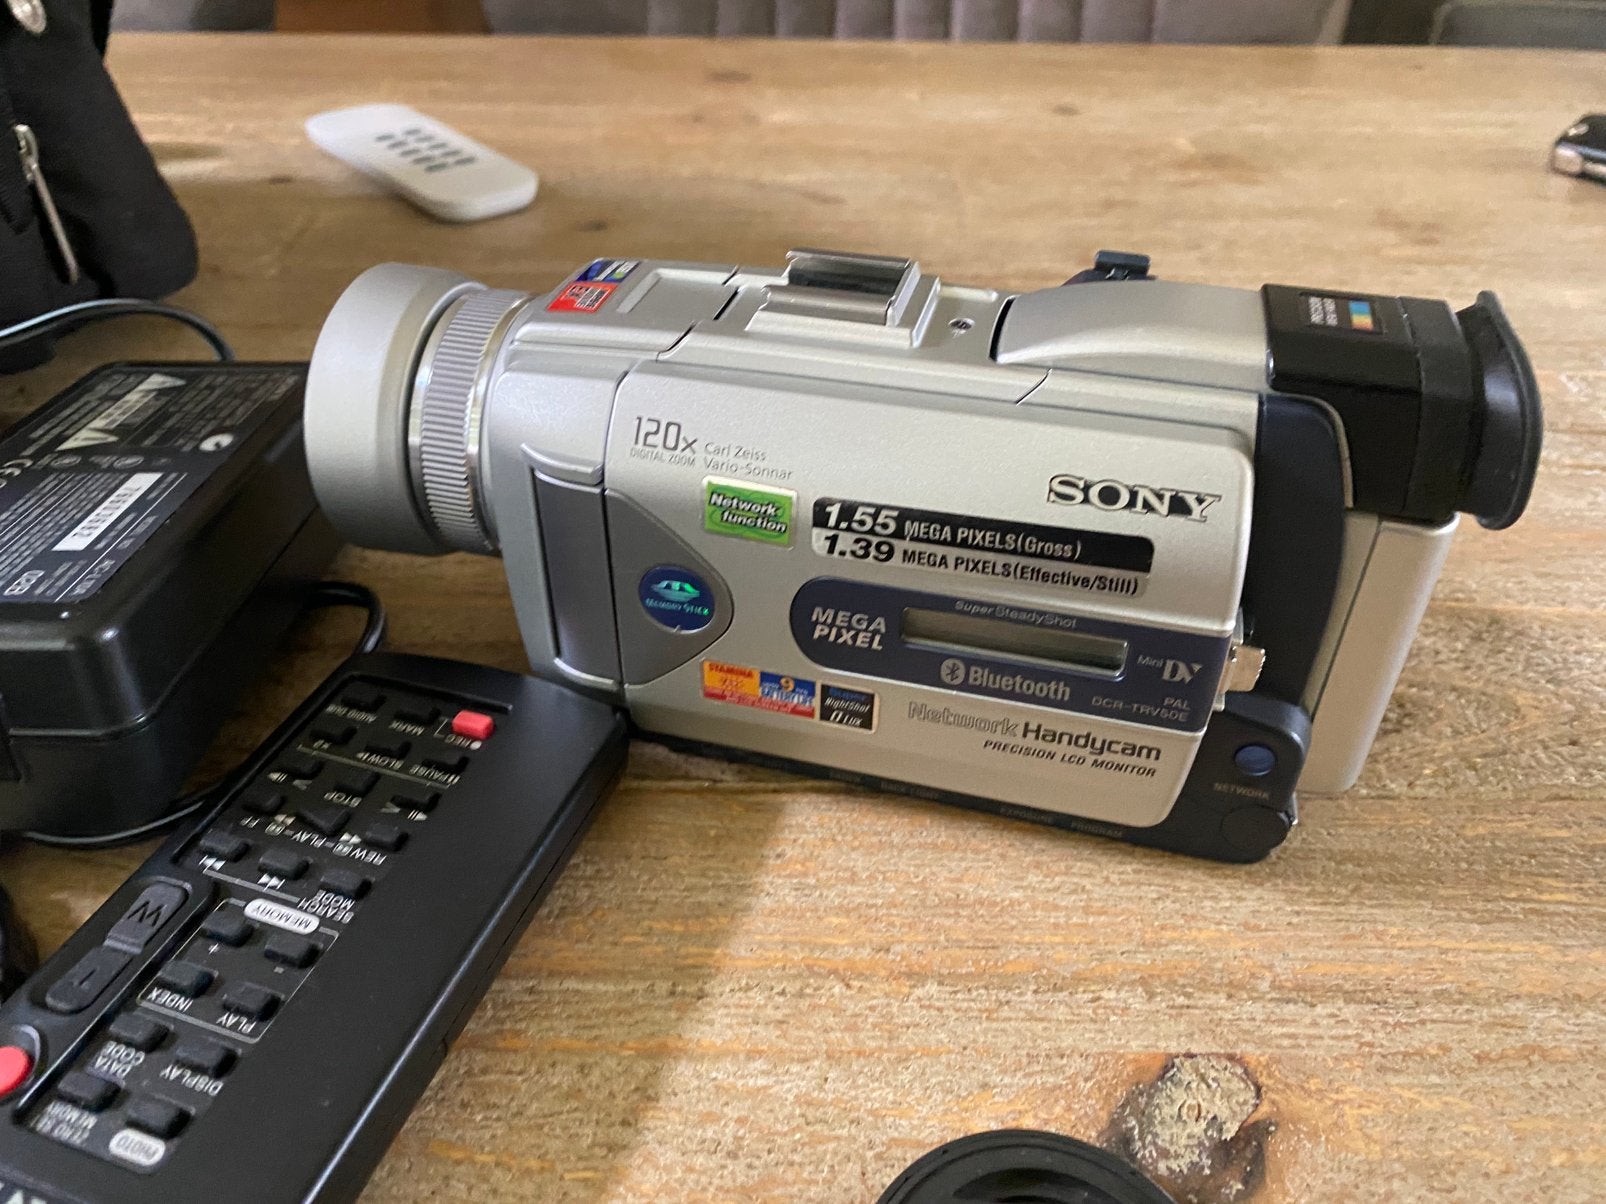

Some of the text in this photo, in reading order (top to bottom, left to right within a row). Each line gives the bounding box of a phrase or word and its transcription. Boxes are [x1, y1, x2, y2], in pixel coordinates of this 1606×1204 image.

[634, 416, 699, 455] 120x
[630, 447, 697, 469] DIGITAL ZOOM
[704, 441, 768, 463] Carl Zeiss
[703, 456, 793, 480] Vario-Sonnar
[709, 492, 780, 517] Network
[1046, 474, 1222, 523] SONY
[721, 510, 788, 535] function
[824, 503, 1082, 561] 1.55 MEGA PIXELS(Gross)
[823, 533, 1139, 597] 1.39 MEGA PIXELS(Effective/Still)
[811, 606, 889, 634] MEGA
[954, 600, 1078, 630] Super SteadyShot
[812, 624, 884, 652] PIXEL
[1136, 653, 1203, 685] Mini DV
[968, 664, 1071, 702] Bluetooth
[325, 702, 378, 725] AUDIO DUB
[823, 696, 872, 715] NightShot
[1163, 696, 1190, 711] PAL
[388, 719, 426, 737] MARK
[907, 701, 1163, 762] Network Handycam
[444, 733, 472, 749] REC
[367, 752, 405, 771] SLOW
[983, 739, 1158, 778] PRECISION LCD MONITOR
[408, 763, 451, 783] PAUSE
[323, 790, 363, 808] STOP
[1213, 782, 1270, 800] NETWORK
[239, 815, 261, 829] FF
[291, 830, 327, 849] PLAY
[350, 847, 388, 866] REW
[296, 896, 355, 924] SEARCH
[313, 888, 356, 912] MODE
[128, 900, 166, 927] W
[256, 903, 312, 930] MEMORY
[147, 986, 194, 1012] INDEX
[215, 1011, 258, 1034] PLAY
[106, 1040, 146, 1067] CODE
[94, 1055, 134, 1079] DATA
[159, 1063, 225, 1097] DISPLAY
